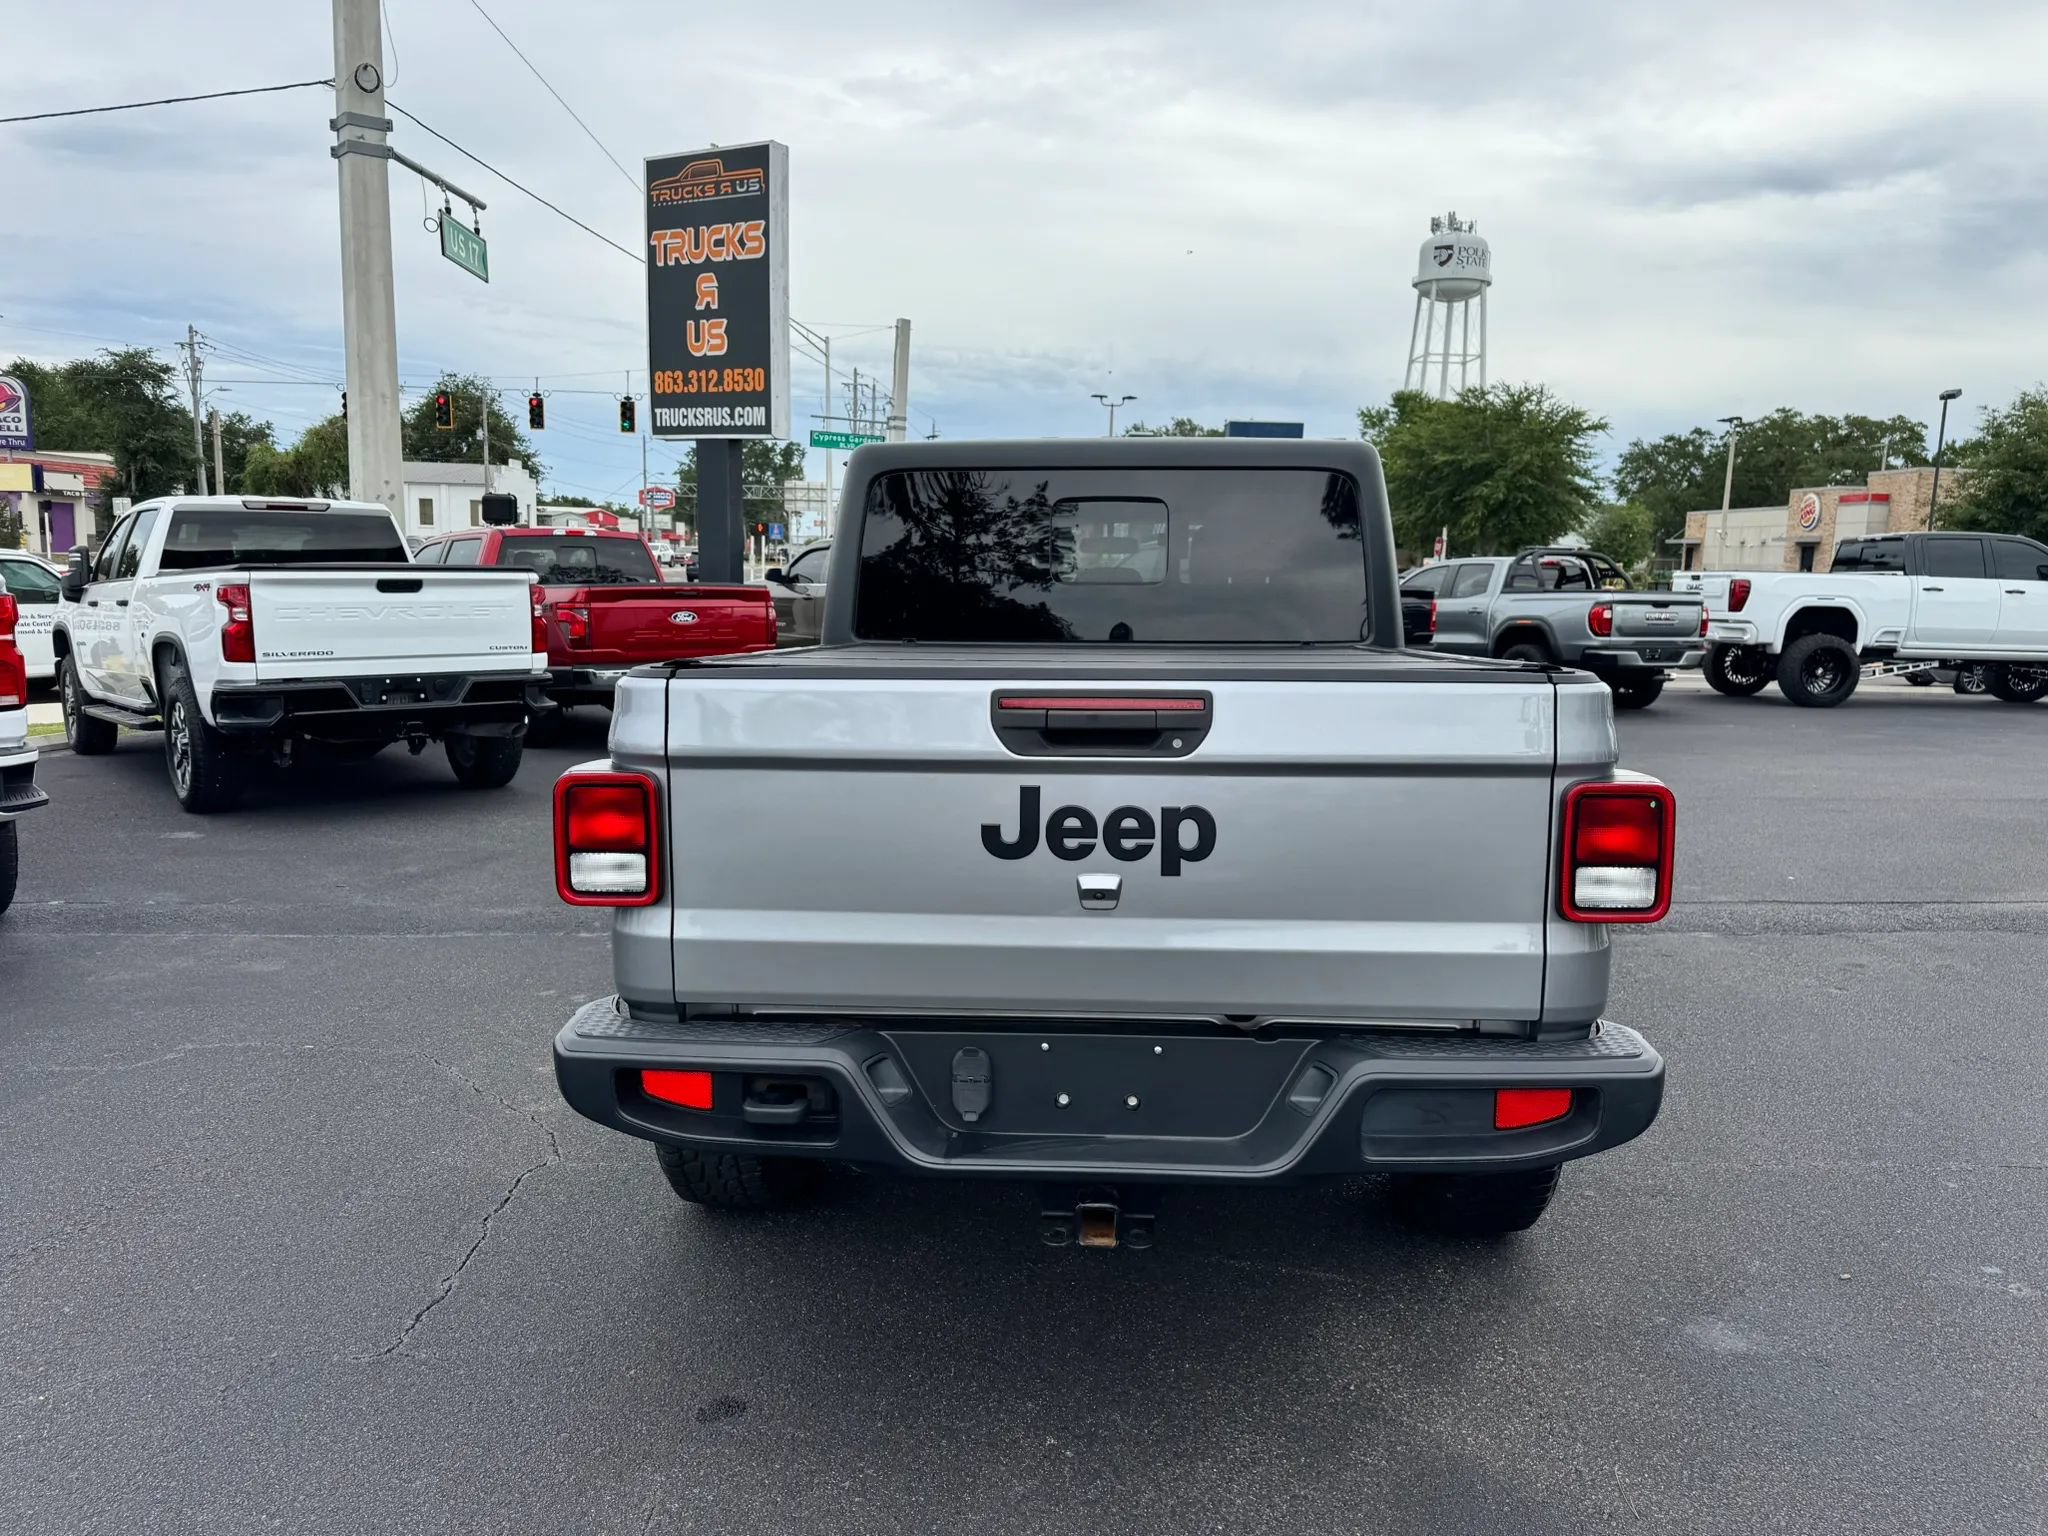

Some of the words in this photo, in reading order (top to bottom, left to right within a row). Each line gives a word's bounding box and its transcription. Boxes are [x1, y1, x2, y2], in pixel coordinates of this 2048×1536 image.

[651, 184, 715, 202] TRUCKS
[736, 178, 760, 193] US
[450, 226, 466, 259] US
[468, 239, 479, 267] 17
[650, 220, 766, 267] TRUCKS
[686, 318, 728, 357] US
[654, 367, 765, 394] 863.312.8530
[654, 406, 766, 427] TRUCKSRUS.COM
[8, 438, 26, 446] Thru
[813, 432, 846, 442] Cypress
[275, 604, 515, 622] CHEVROLET
[262, 650, 334, 658] SILVERADO
[981, 784, 1217, 876] Jeep
